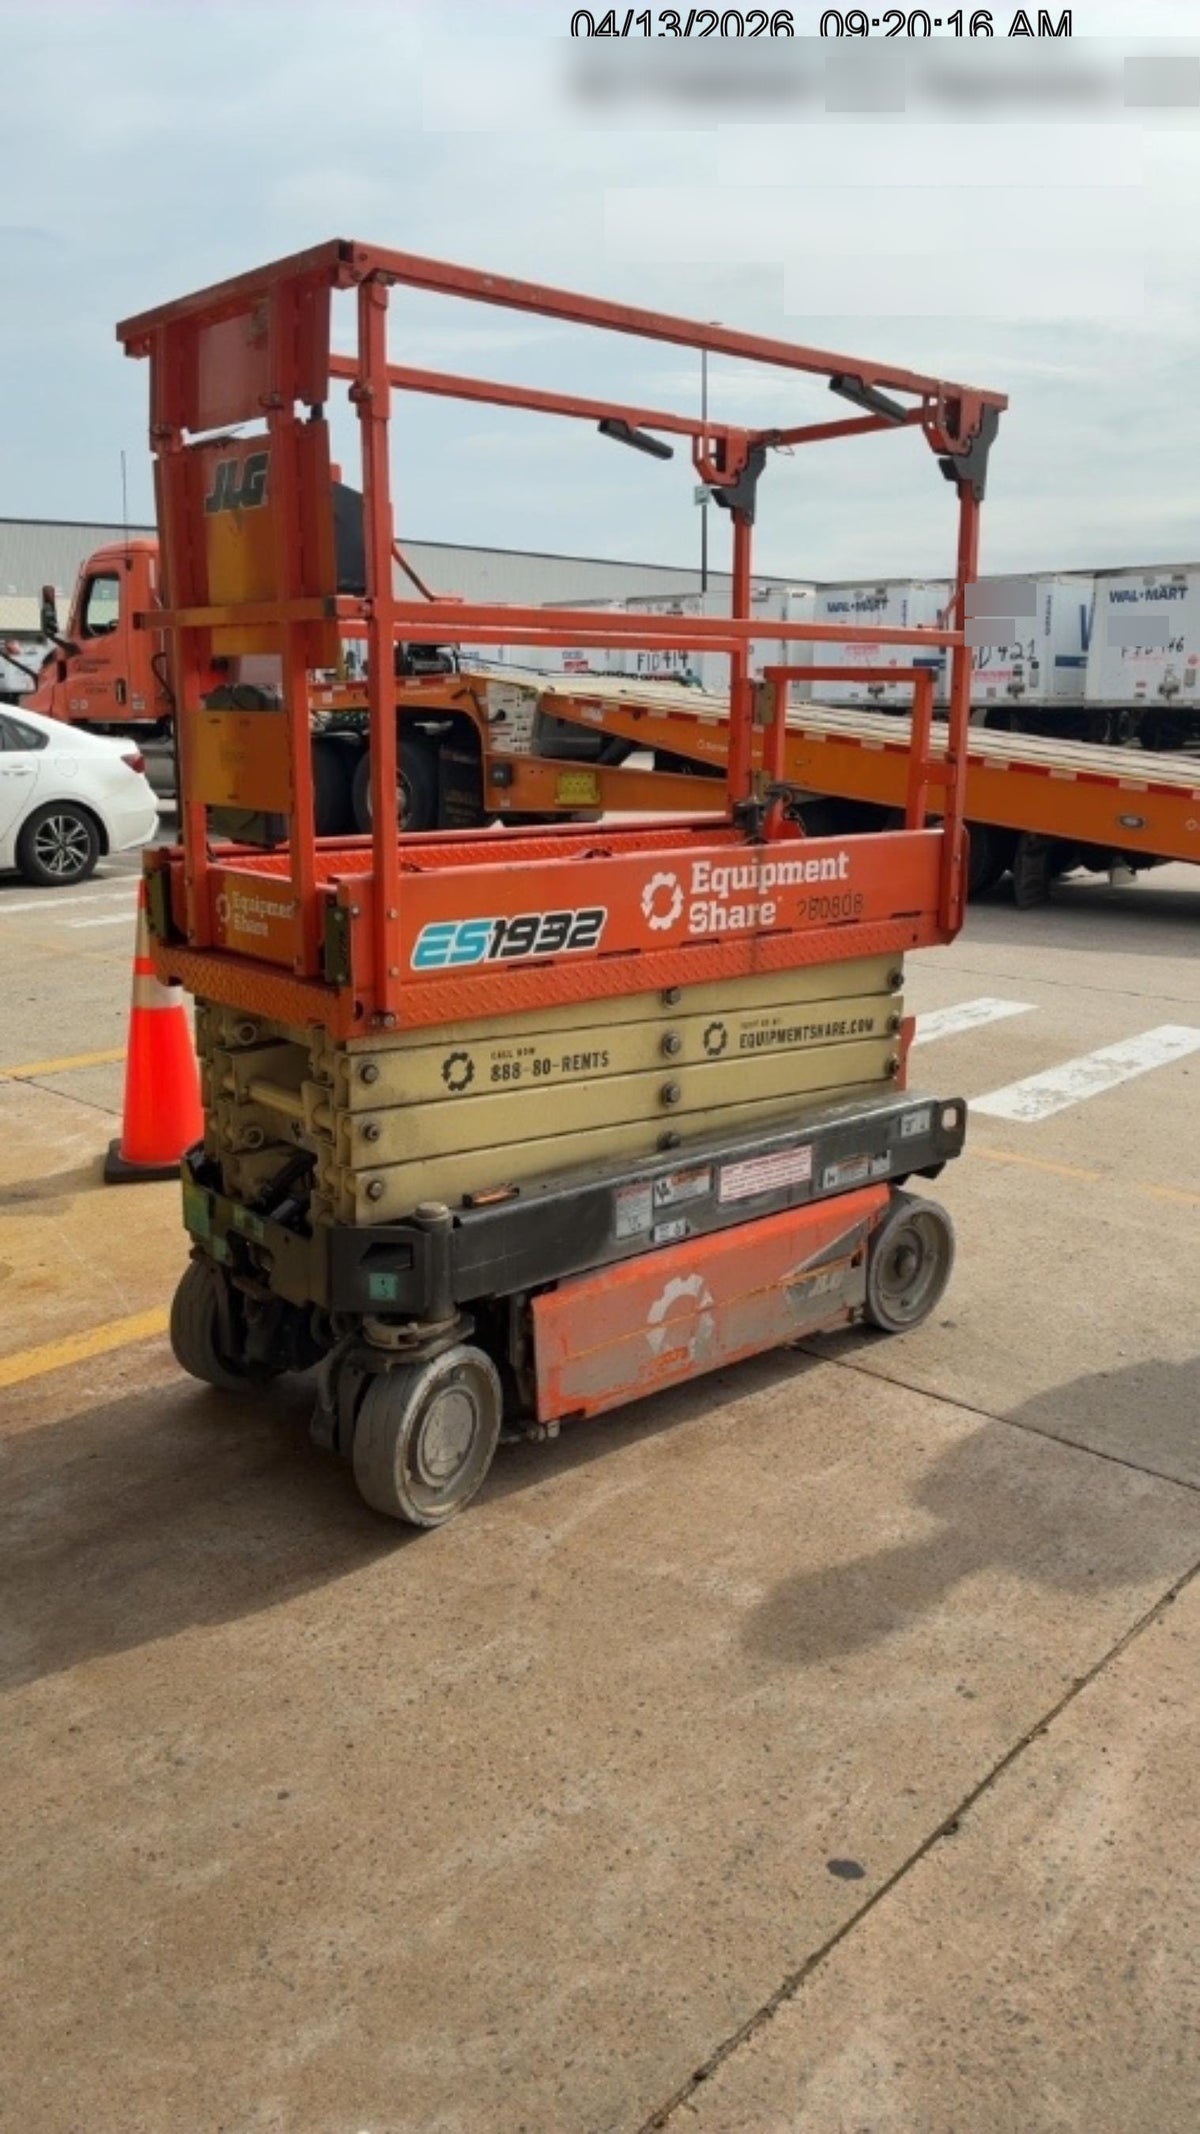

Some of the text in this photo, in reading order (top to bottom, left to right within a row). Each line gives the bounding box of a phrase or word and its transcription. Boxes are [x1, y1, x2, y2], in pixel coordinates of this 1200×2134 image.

[204, 450, 271, 516] JLG
[690, 851, 849, 899] Equipment
[411, 906, 608, 969] ES1932
[689, 900, 777, 934] Share
[739, 1017, 874, 1049] EQUIPMENTSHARE.COM
